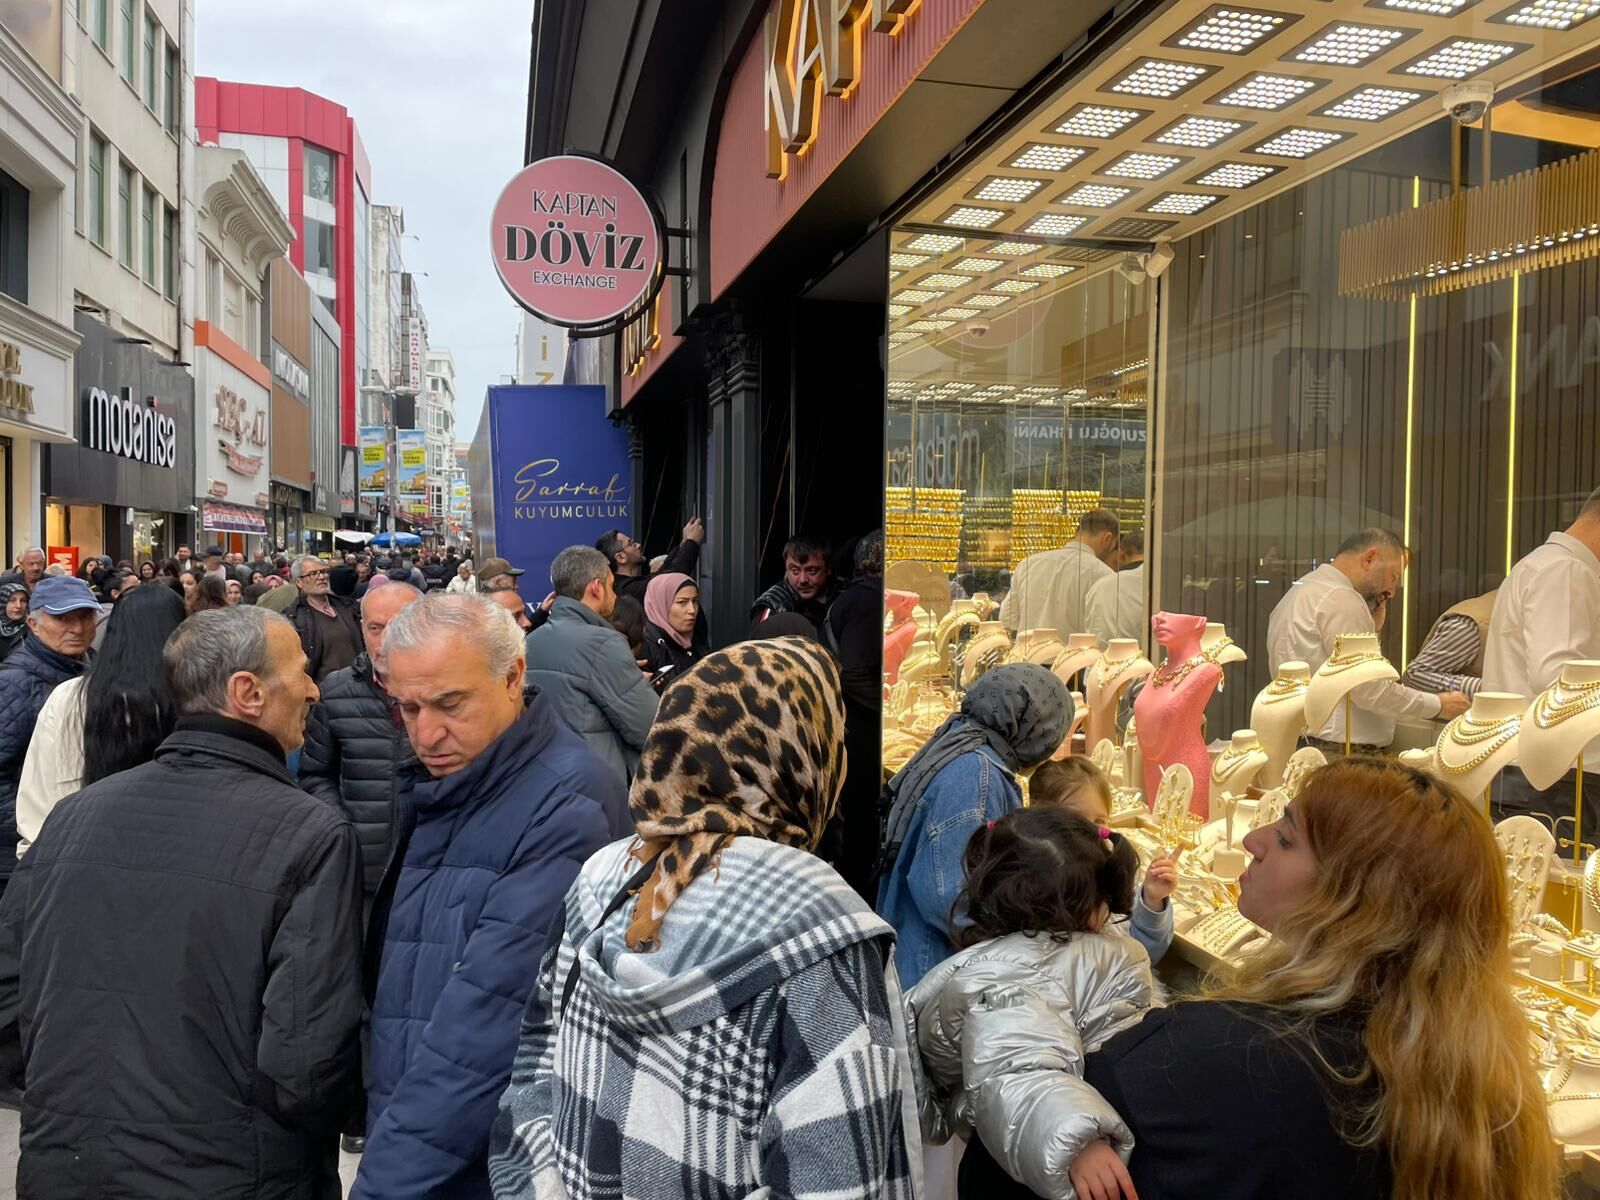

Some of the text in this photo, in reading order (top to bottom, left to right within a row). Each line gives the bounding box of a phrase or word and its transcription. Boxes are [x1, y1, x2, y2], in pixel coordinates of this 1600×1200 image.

[532, 190, 616, 217] KAPTAN
[504, 220, 646, 270] DÖVİZ
[533, 271, 616, 289] EXCHANGE
[88, 386, 176, 469] modanisa
[514, 458, 625, 504] Sarraf
[514, 505, 628, 519] KUYUMCULUK
